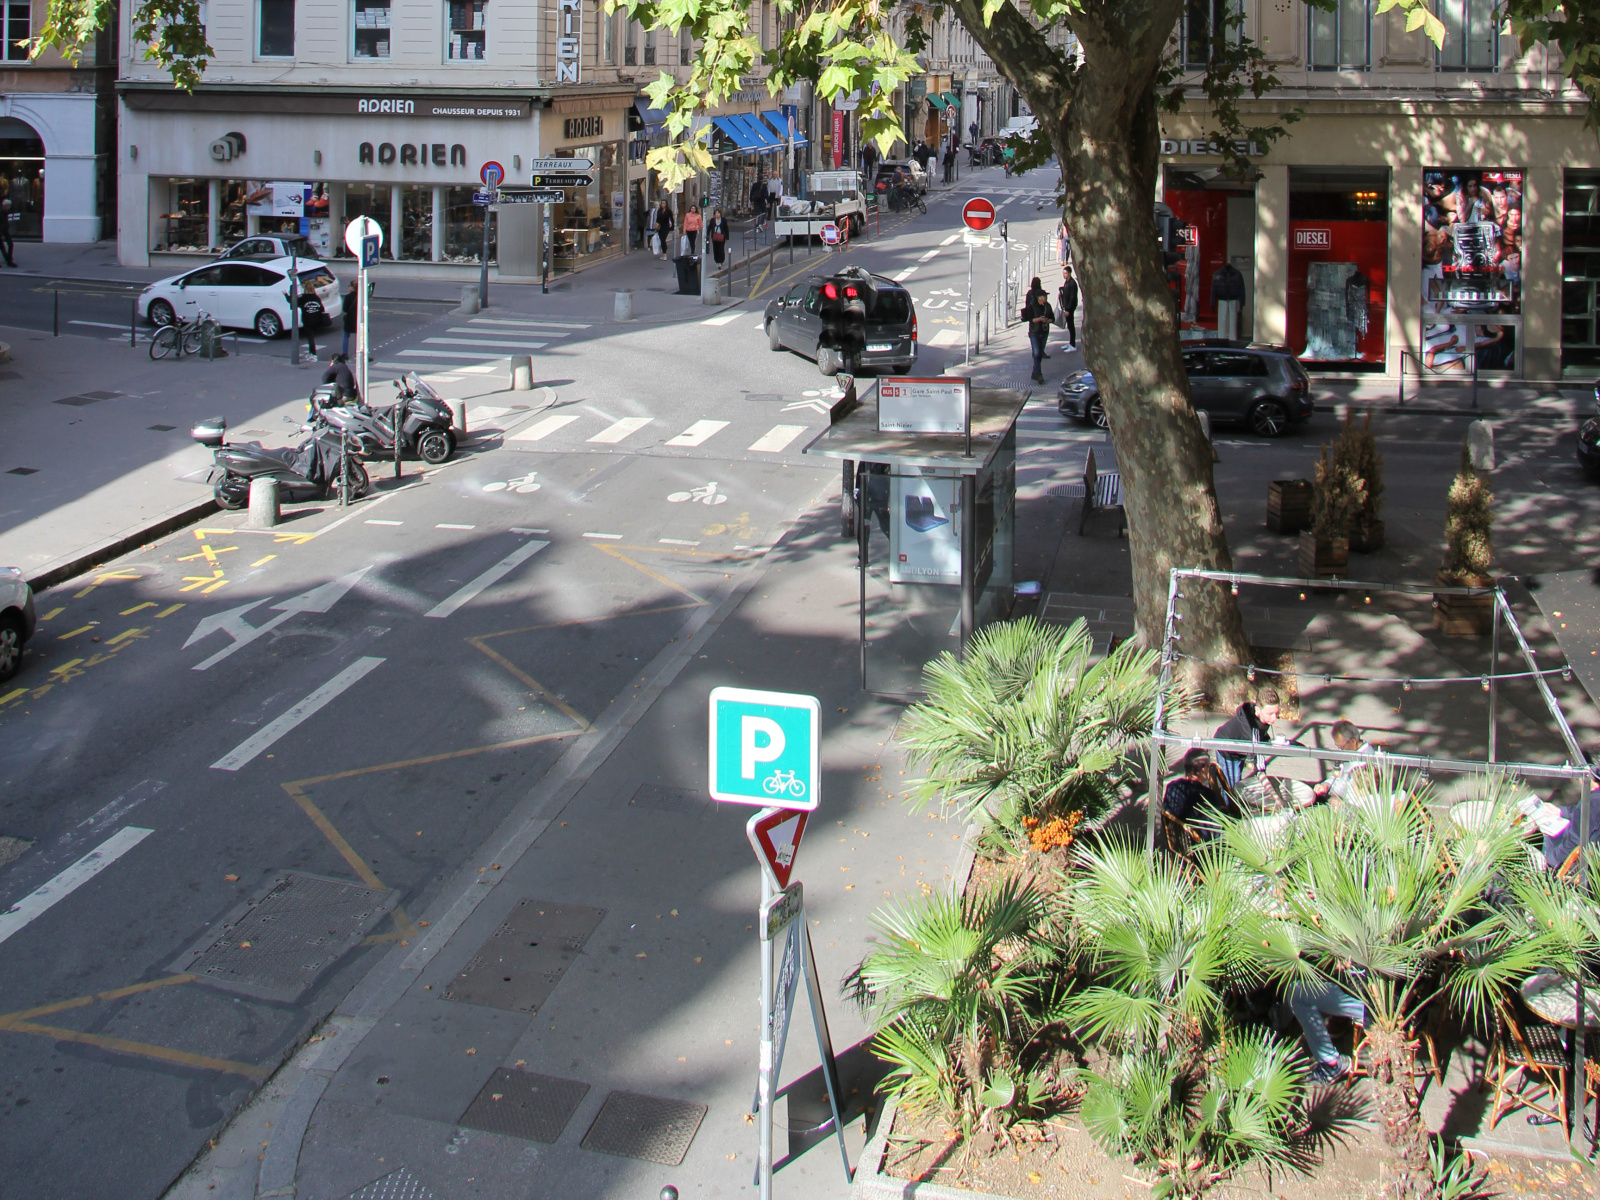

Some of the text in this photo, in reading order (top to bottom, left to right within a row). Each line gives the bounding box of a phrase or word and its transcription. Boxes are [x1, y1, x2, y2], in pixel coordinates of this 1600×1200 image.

[358, 98, 521, 116] ADRIEN CHAUSSEUR DEPUIS 1931
[564, 116, 604, 139] ADRIEN
[359, 141, 467, 166] ADRIEN
[534, 176, 541, 185] P
[1296, 231, 1328, 245] DIESEL
[366, 241, 375, 262] P
[882, 387, 893, 395] BUS
[880, 421, 913, 429] Saint-Nizier
[741, 714, 786, 780] P
